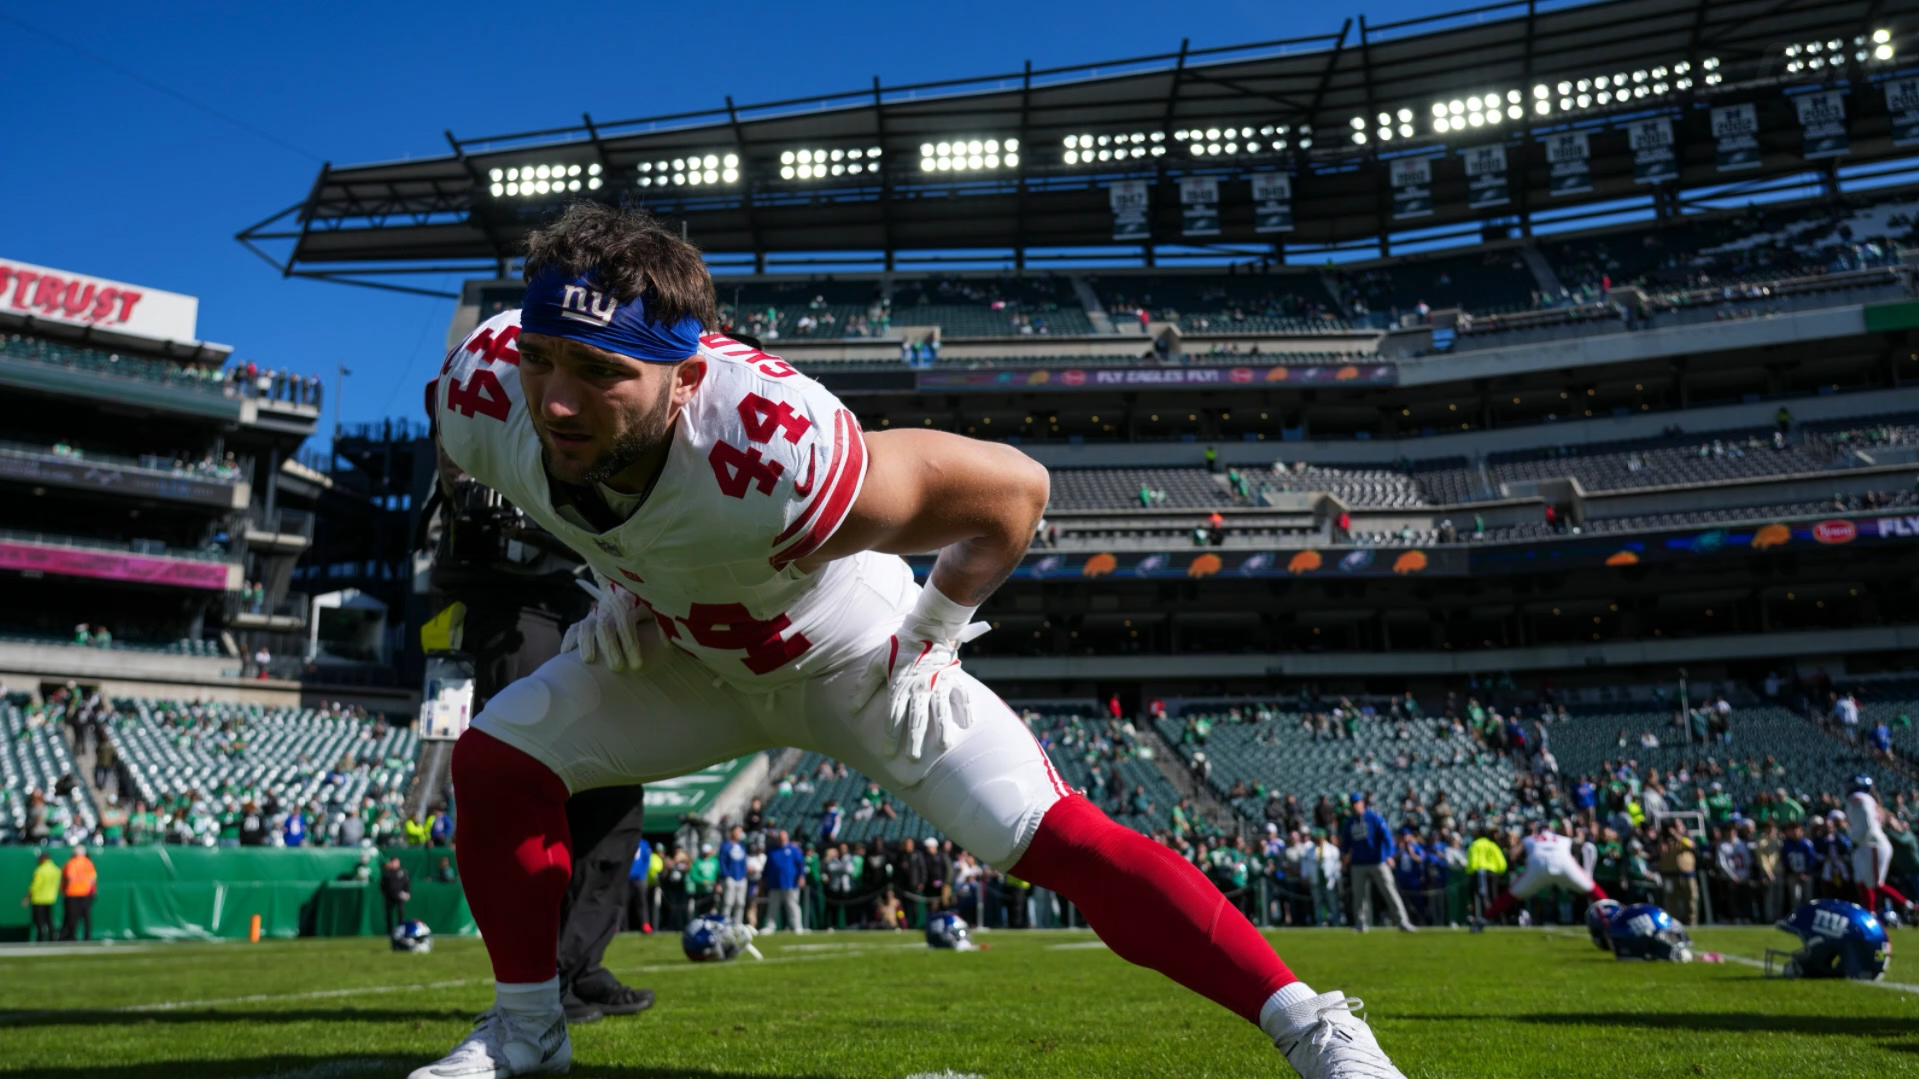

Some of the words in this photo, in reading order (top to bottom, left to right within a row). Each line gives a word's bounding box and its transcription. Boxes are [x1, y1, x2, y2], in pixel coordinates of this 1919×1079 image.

[1096, 369, 1122, 384] FLY
[1126, 369, 1184, 383] EAGLES
[708, 391, 812, 499] 44
